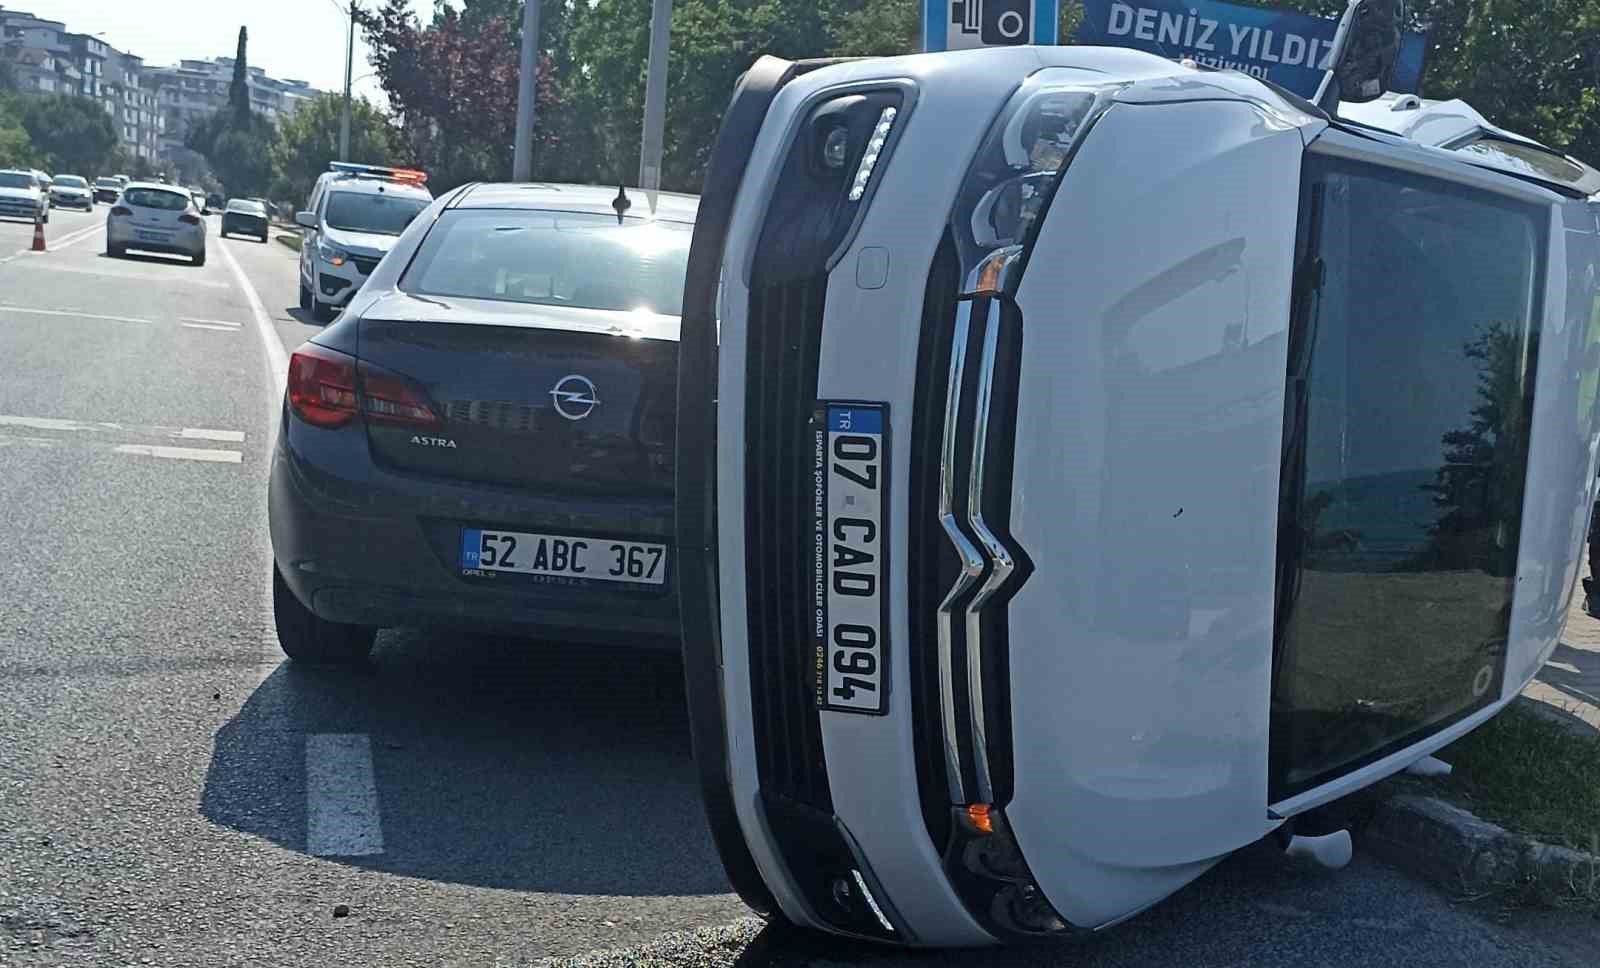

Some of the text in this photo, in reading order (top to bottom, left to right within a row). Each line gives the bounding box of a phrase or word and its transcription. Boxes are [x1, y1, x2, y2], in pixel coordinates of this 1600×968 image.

[1107, 3, 1218, 51] DENİZ
[839, 410, 851, 430] TR
[410, 435, 457, 448] ASTRA
[815, 520, 823, 532] VE
[466, 551, 479, 561] TR
[481, 534, 663, 579] 52 ABC 367
[833, 435, 877, 700] 07 CAD 094
[815, 608, 824, 637] ODASI
